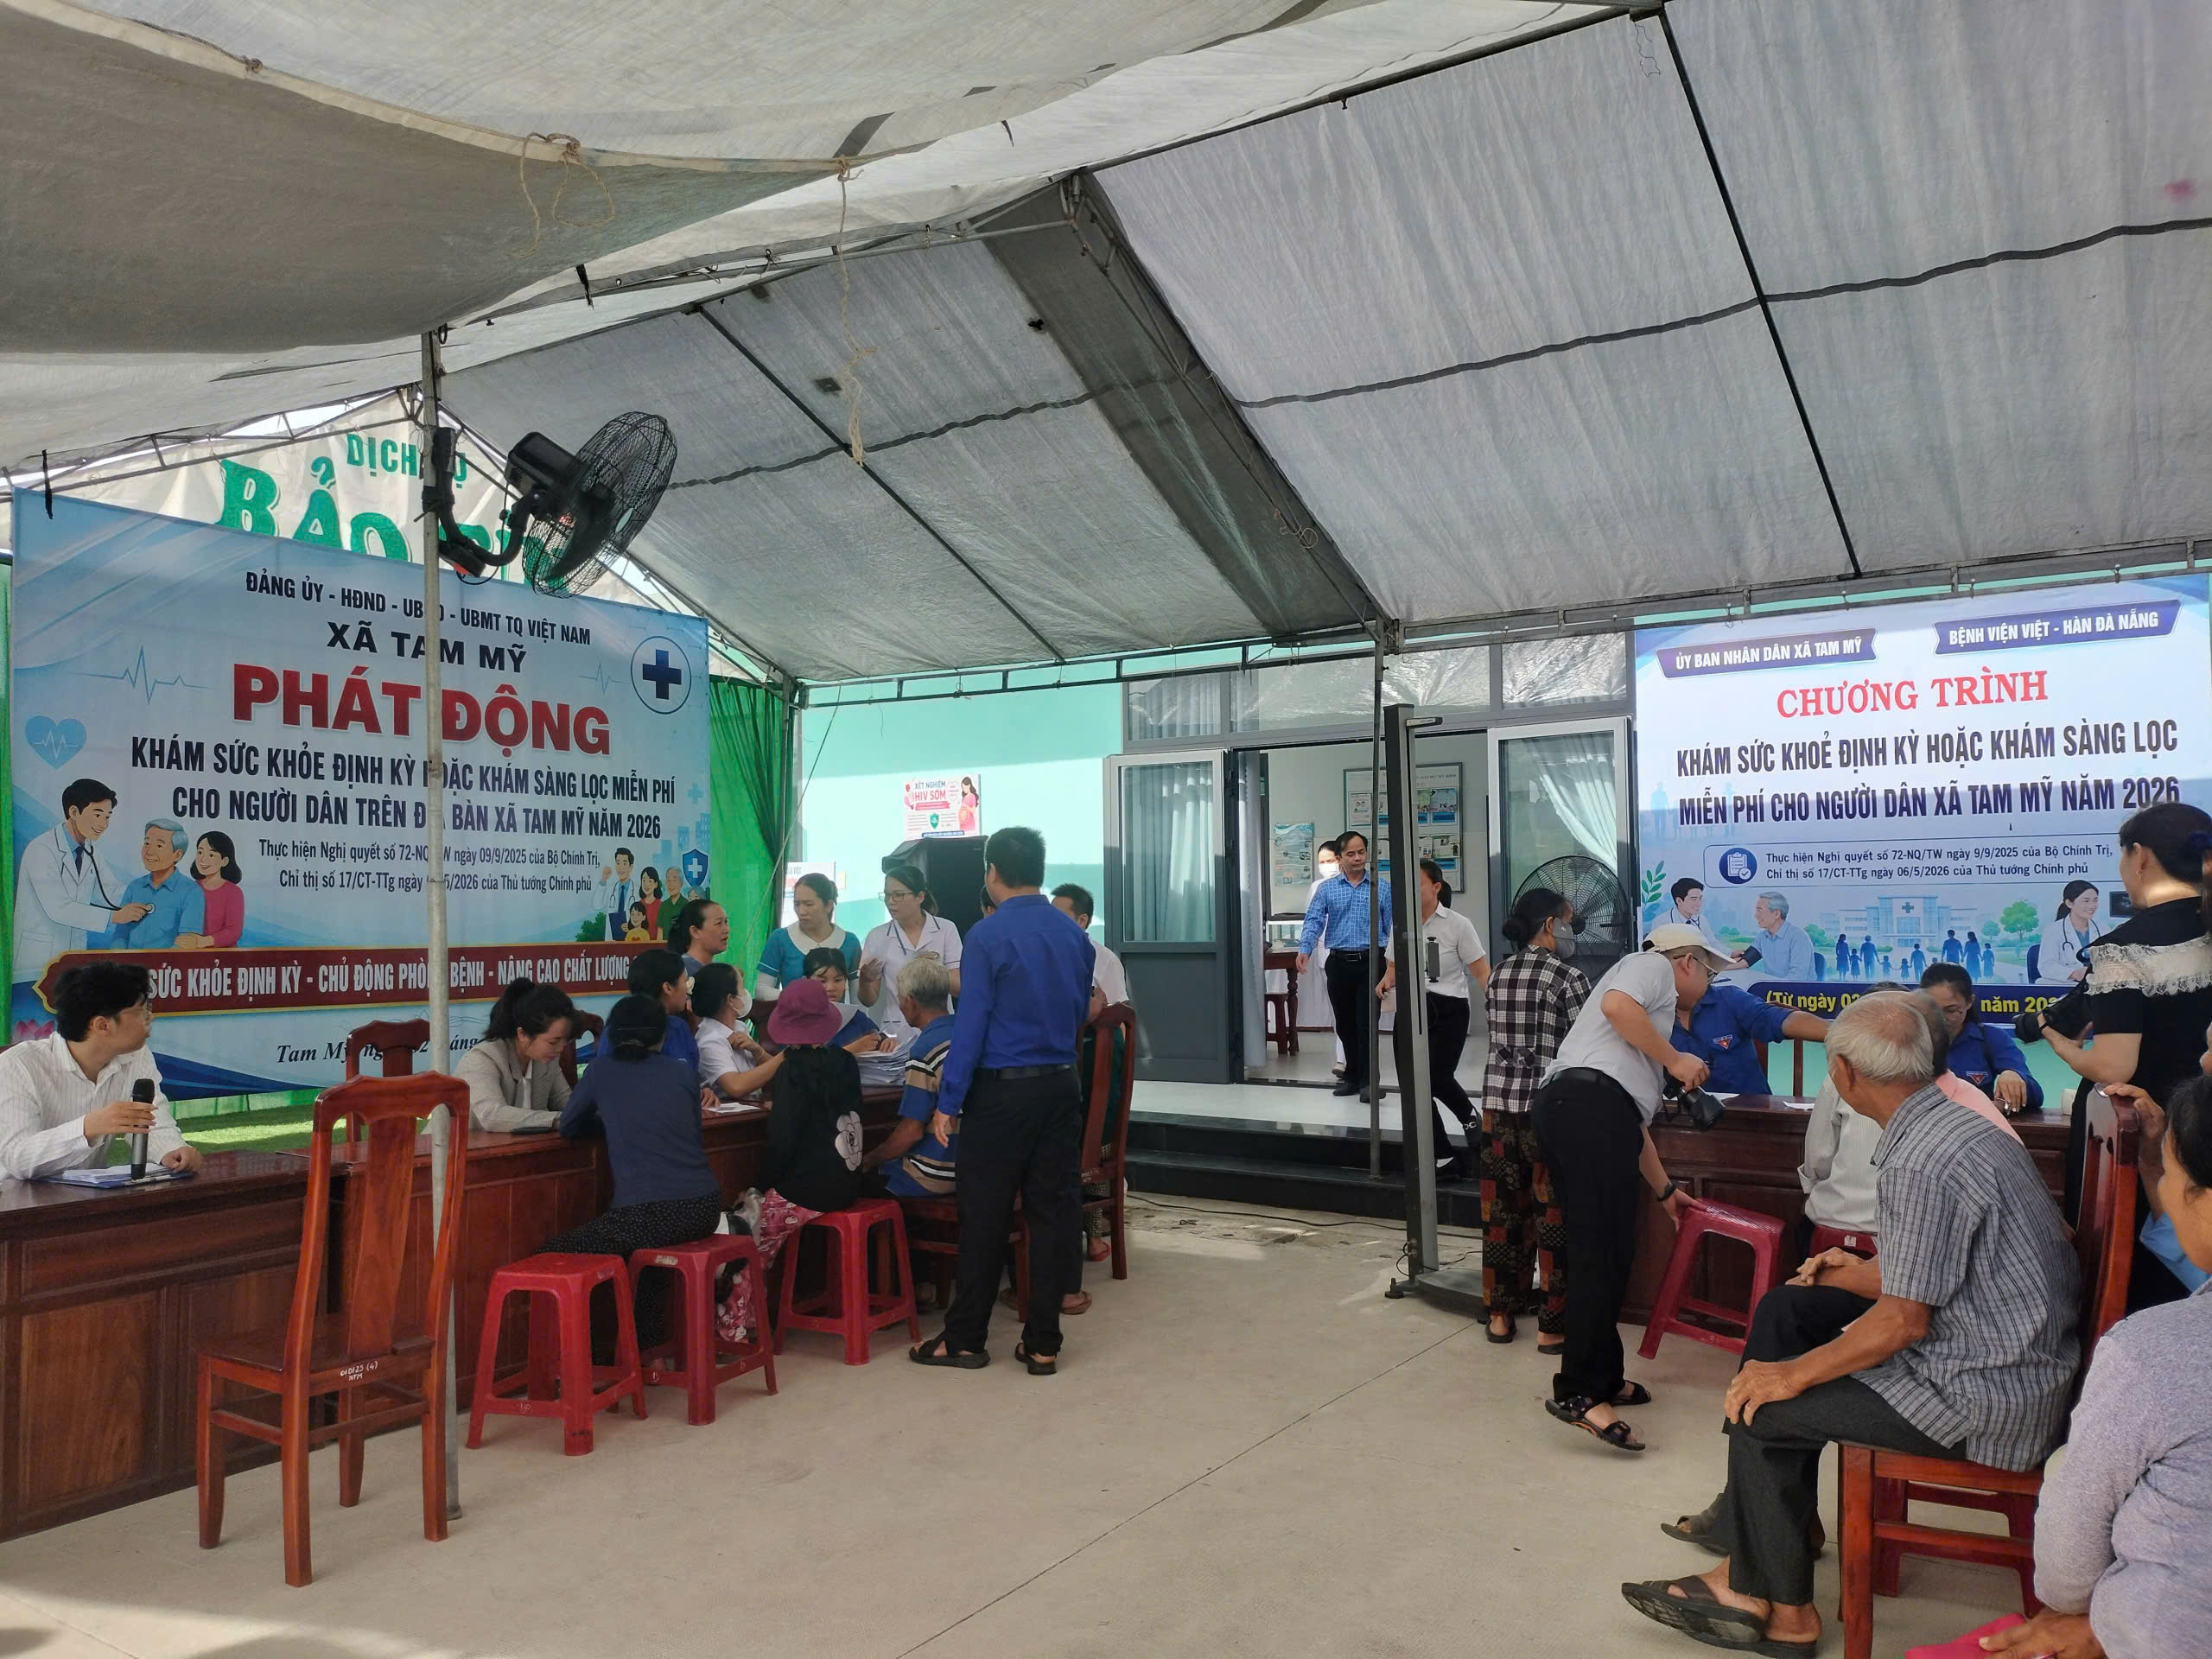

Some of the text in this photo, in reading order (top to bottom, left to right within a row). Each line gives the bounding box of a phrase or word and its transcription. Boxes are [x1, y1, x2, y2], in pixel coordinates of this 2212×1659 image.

[346, 434, 418, 476] DỊCH
[246, 569, 296, 599] ĐẢNG
[302, 575, 323, 602] ỦY
[341, 588, 386, 613] HĐND
[404, 598, 444, 621] UB
[461, 607, 501, 632] UBMT
[505, 615, 523, 636] TQ
[528, 618, 556, 643] VIỆT
[562, 626, 590, 645] NAM
[1949, 626, 1984, 647] BỆNH
[1987, 622, 2018, 644] VIỆN
[2022, 620, 2050, 640] VIỆT
[2063, 615, 2092, 634] HÀN
[2095, 613, 2114, 632] ĐÀ
[2119, 608, 2158, 630] NẴNG
[327, 620, 378, 653] XÃ
[480, 643, 527, 672] MỸ
[1675, 636, 1862, 671] ỦY BAN NHÂN DÂN XÃ TAM MỸ
[233, 664, 610, 758] PHÁT ĐỘNG
[1777, 666, 2048, 718] CHƯƠNG TRÌNH
[1677, 718, 2177, 777] KHÁM SỨC KHOẺ ĐỊNH KỲ HOẶC KHÁM SÀNG LỌC
[131, 734, 205, 772] KHÁM
[213, 739, 259, 776] SỨC
[267, 741, 325, 780] KHỎE
[333, 753, 383, 789] ĐỊNH
[391, 753, 416, 787] KỲ
[480, 762, 529, 794] KHÁM
[534, 766, 577, 798] SÀNG
[582, 773, 608, 804] LỌC
[613, 769, 648, 803] MIỄN
[652, 776, 675, 804] PHÍ
[173, 786, 220, 819] CHO
[229, 787, 297, 823] NGƯỜI
[306, 790, 347, 824] DÂN
[355, 794, 407, 828] TRÊN
[452, 799, 488, 831] BÀN
[494, 802, 518, 833] XÃ
[523, 808, 556, 836] TAM
[562, 807, 585, 836] MỸ
[588, 808, 622, 837] NĂM
[626, 814, 661, 839] 2026
[915, 791, 928, 801] HIV
[1679, 773, 2179, 825] MIỄN PHÍ CHO NGƯỜI DÂN XÃ TAM MỸ NĂM 2026
[259, 838, 288, 861] Thực
[292, 840, 316, 859] hiện
[321, 841, 346, 862] Nghị
[350, 841, 380, 863] quyết
[384, 842, 396, 861] số
[454, 847, 477, 866] ngày
[480, 848, 527, 866] 09/9/2025
[529, 849, 544, 865] của
[547, 849, 558, 867] Bộ
[562, 850, 584, 866] Chính
[587, 852, 600, 868] Trị,
[1766, 844, 2113, 864] Thực hiện Nghị quyết số 72-NQ/TW ngày 9/9/2025 của Bộ Chính Trị,
[1766, 862, 2088, 880] Chỉ thị số 17/CT-TTg ngày 06/5/2026 của Thủ tướng Chính phủ
[279, 869, 299, 888] Chỉ
[303, 871, 318, 891] thị
[322, 871, 335, 888] số
[339, 871, 395, 893] 17/CT-TTg
[398, 873, 423, 893] ngày
[481, 874, 499, 890] của
[501, 874, 518, 891] Thủ
[521, 874, 547, 893] tướng
[550, 875, 574, 891] Chính
[576, 876, 592, 893] phủ
[147, 963, 181, 999] SỨC
[188, 958, 232, 997] KHỎE
[238, 966, 276, 1002] ĐỊNH
[282, 960, 302, 994] KỲ
[319, 957, 348, 993] CHỦ
[353, 958, 394, 997] ĐỘNG
[398, 957, 429, 989] PHÒ
[450, 957, 485, 993] BỆNH
[498, 955, 533, 985] NÂNG
[537, 958, 560, 983] CAO
[564, 950, 591, 982] CHẤT
[595, 956, 630, 985] LƯỢNG
[1797, 992, 1836, 1012] ngày
[1980, 996, 2018, 1013] năm
[276, 1045, 317, 1063] Tam
